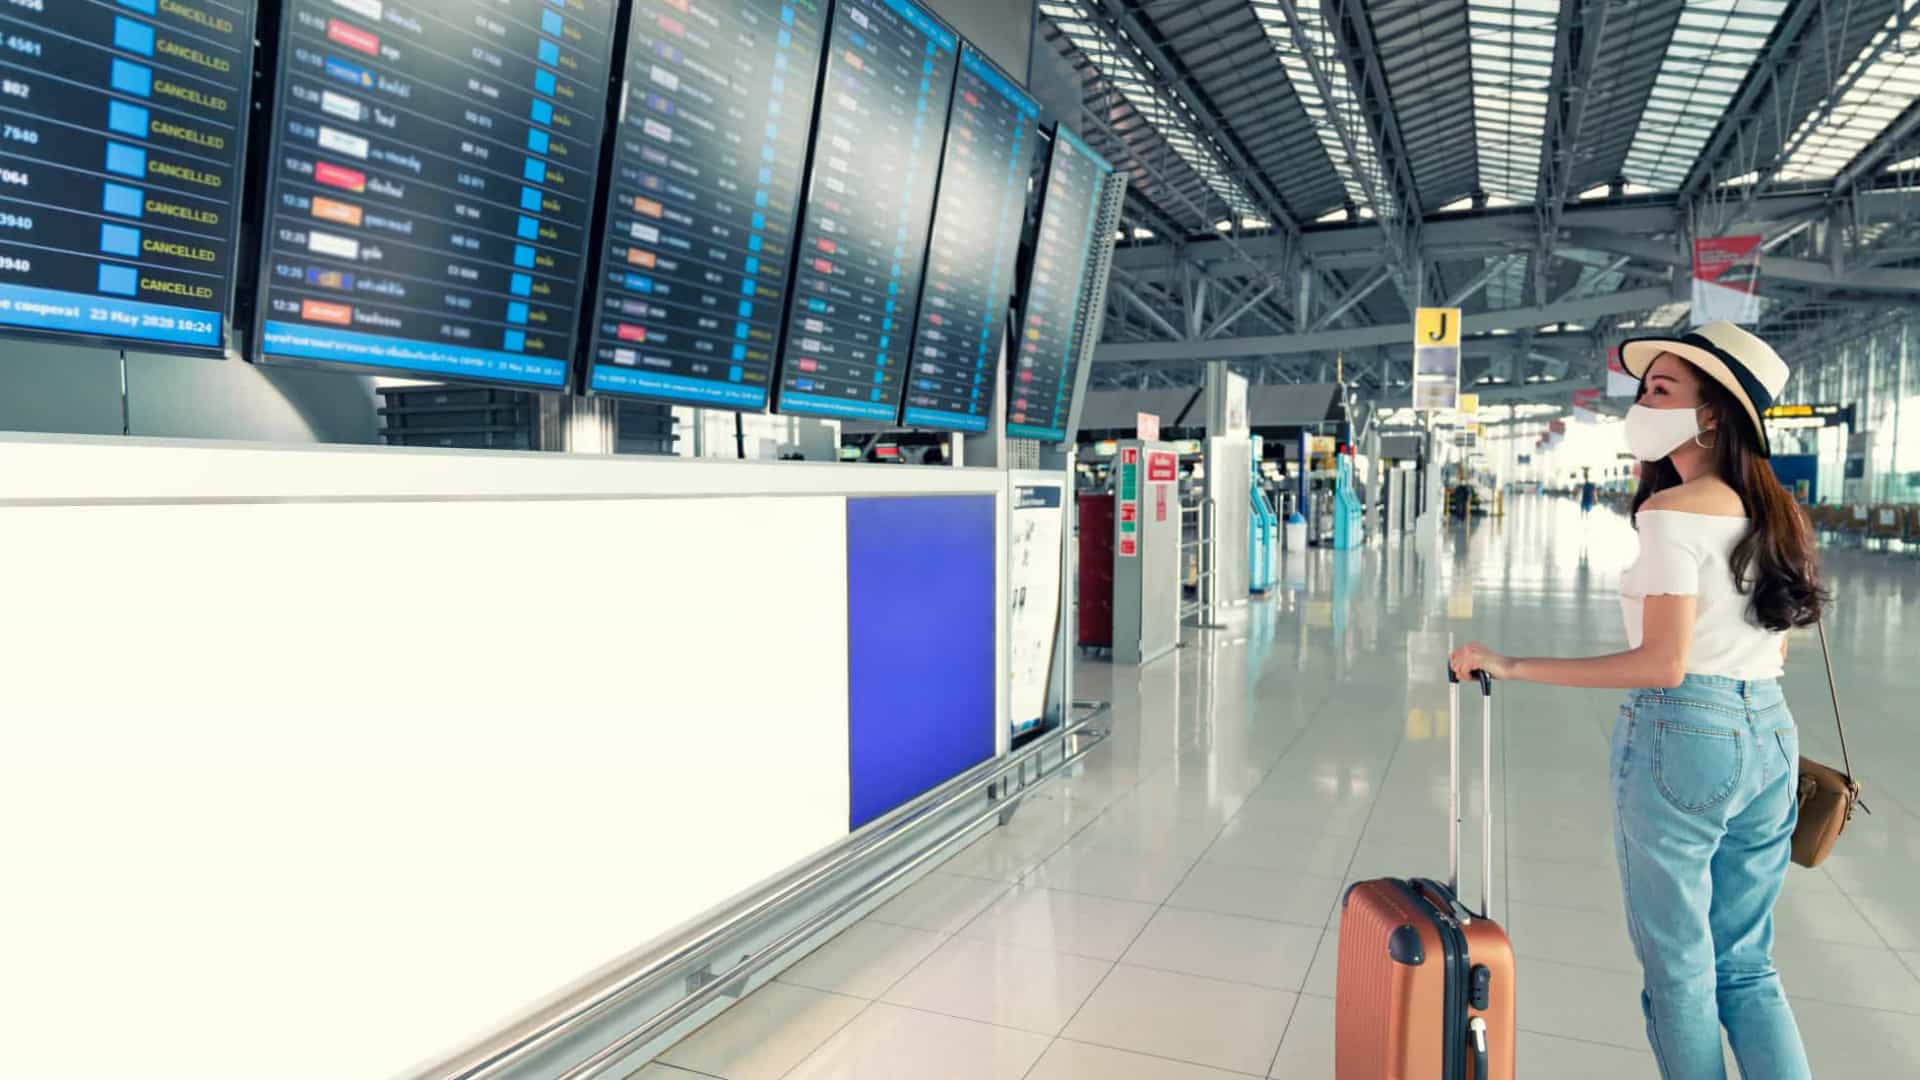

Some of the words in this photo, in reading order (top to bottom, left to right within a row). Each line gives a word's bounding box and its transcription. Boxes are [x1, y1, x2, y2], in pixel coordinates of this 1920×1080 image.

[159, 0, 233, 33] CANCELLED
[156, 39, 230, 72] CANCELLED
[153, 79, 227, 111] CANCELLED
[151, 120, 225, 149] CANCELLED
[0, 168, 29, 187] 064
[148, 160, 222, 187] CANCELLED
[145, 200, 218, 225] CANCELLED
[143, 239, 216, 262] CANCELLED
[140, 277, 213, 299] CANCELLED
[111, 311, 139, 329] May
[177, 318, 213, 334] 10:24
[1428, 312, 1447, 341] J
